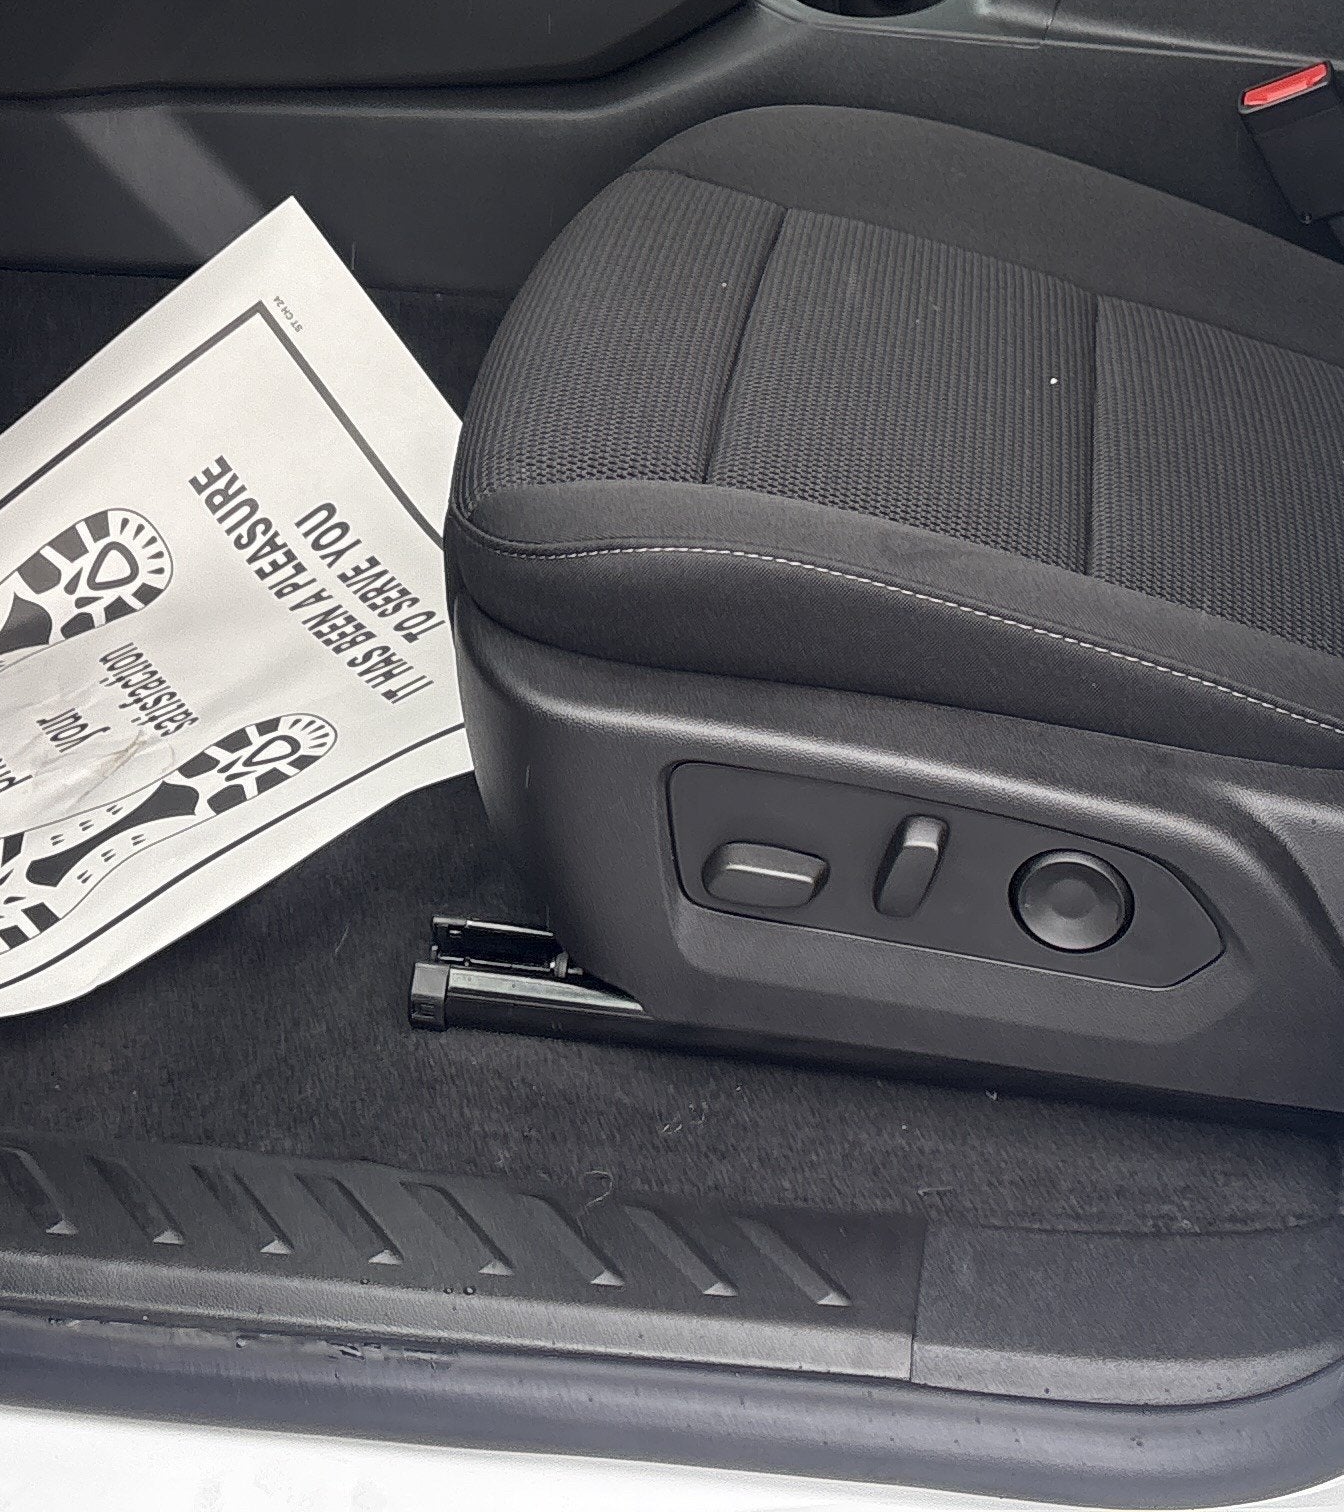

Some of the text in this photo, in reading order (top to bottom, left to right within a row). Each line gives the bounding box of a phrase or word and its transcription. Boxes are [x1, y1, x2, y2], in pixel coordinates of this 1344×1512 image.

[273, 295, 303, 333] ST CH 24
[188, 454, 434, 704] IT HAS BEEN A PLEASURE
[294, 502, 446, 644] TO SERVE YOU
[36, 708, 111, 753] your
[99, 642, 200, 737] satisfaction
